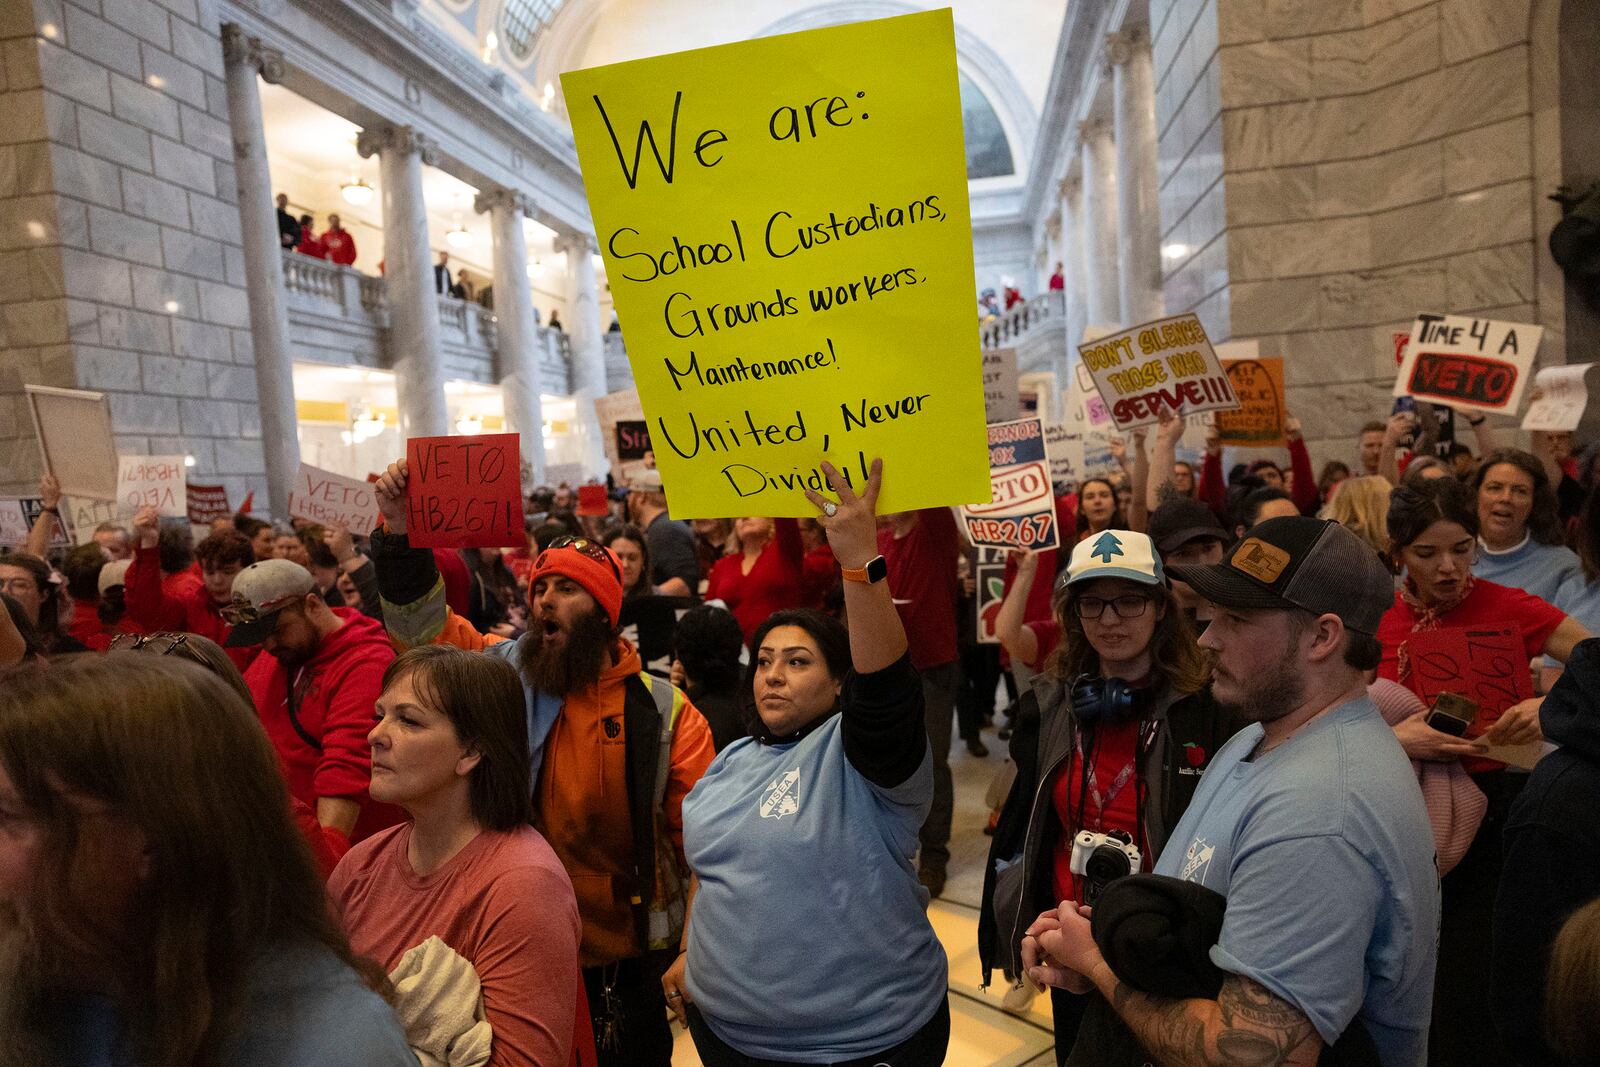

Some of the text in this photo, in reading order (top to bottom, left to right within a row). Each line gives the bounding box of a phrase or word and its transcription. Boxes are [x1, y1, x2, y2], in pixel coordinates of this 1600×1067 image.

[592, 91, 869, 190] We are:
[608, 195, 947, 282] School Custodians,
[664, 290, 799, 339] Grounds
[1083, 319, 1206, 372] DON'T SILENCE
[1470, 320, 1490, 351] 4
[1499, 329, 1519, 355] A
[663, 336, 840, 392] Maintenance!
[1107, 351, 1208, 395] THOSE WHO
[1420, 358, 1513, 401] VETO
[839, 394, 931, 432] Never
[1113, 376, 1233, 424] SERVE!!!
[988, 421, 1040, 446] ERNOR
[990, 446, 1017, 466] OX
[304, 474, 370, 508] VETO
[991, 473, 1040, 502] ETO
[409, 495, 512, 536] HB267!
[969, 512, 1053, 546] HB267
[767, 779, 793, 807] USEA
